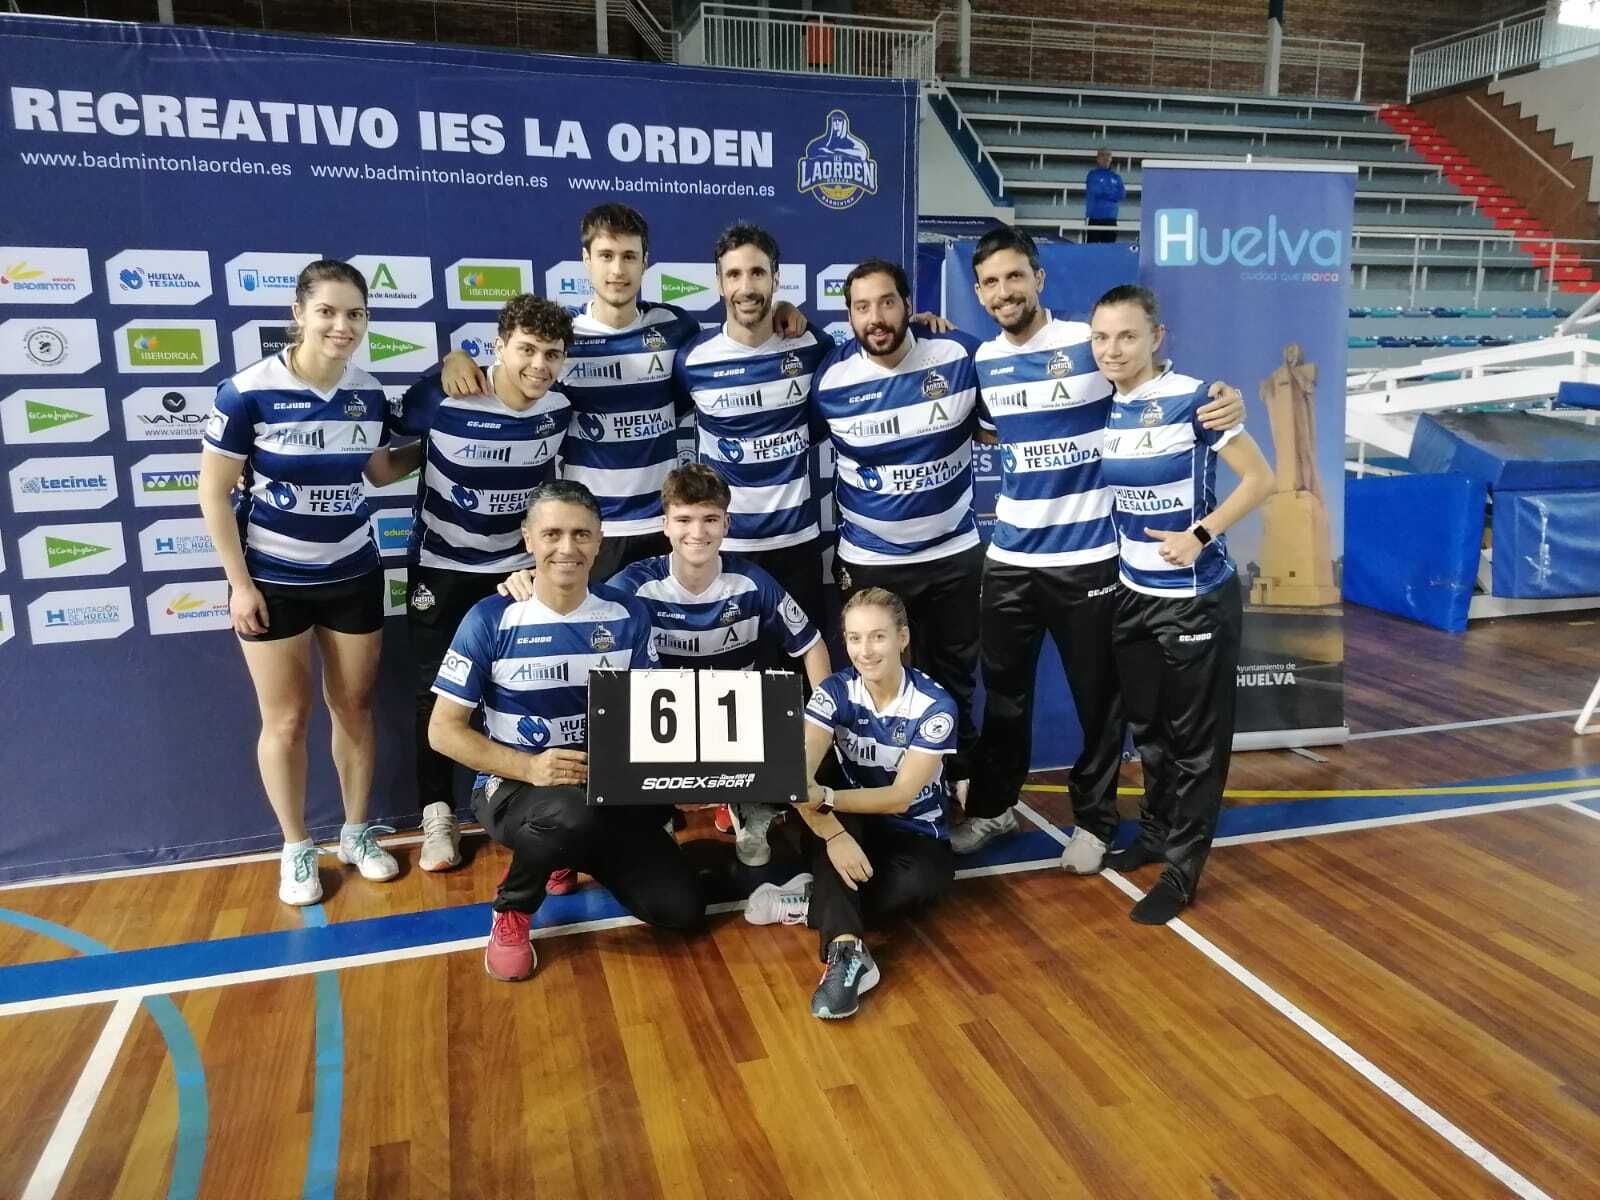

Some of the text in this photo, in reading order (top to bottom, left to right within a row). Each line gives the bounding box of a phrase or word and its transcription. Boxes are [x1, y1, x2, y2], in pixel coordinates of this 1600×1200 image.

[11, 86, 773, 168] RECREATIVO IES LA ORDEN
[21, 150, 292, 176] www.badmintonlaorden.es
[311, 162, 548, 189] www.badmintonlaorden.es
[801, 161, 875, 189] LAORDEN
[568, 176, 775, 198] www.badmintonlaorden.es
[1160, 214, 1342, 267] Huelva
[148, 273, 185, 281] HUELVA
[263, 275, 297, 284] LOTER
[469, 288, 518, 297] IBERDROLA
[141, 352, 198, 360] IBERDROLA
[141, 414, 210, 424] VANDA
[613, 412, 663, 428] HUELVA
[615, 419, 674, 439] TE SALUDA
[753, 431, 800, 450] HUELVA
[755, 450, 770, 460] TE
[1024, 441, 1078, 457] HUELVA
[1026, 448, 1101, 469] TE SALUDA
[893, 460, 949, 480] HUELVA
[894, 461, 963, 491] TE SALUDA
[41, 475, 107, 489] tecinet
[1116, 488, 1157, 500] HUELVA
[309, 501, 330, 512] TE
[489, 503, 504, 513] TE
[1131, 497, 1183, 512] SALUDA
[83, 612, 119, 620] HUELVA
[517, 636, 552, 645] CEJUDO
[1286, 662, 1296, 670] de
[1236, 672, 1296, 687] HUELVA
[650, 688, 678, 743] 6
[717, 689, 738, 742] 1
